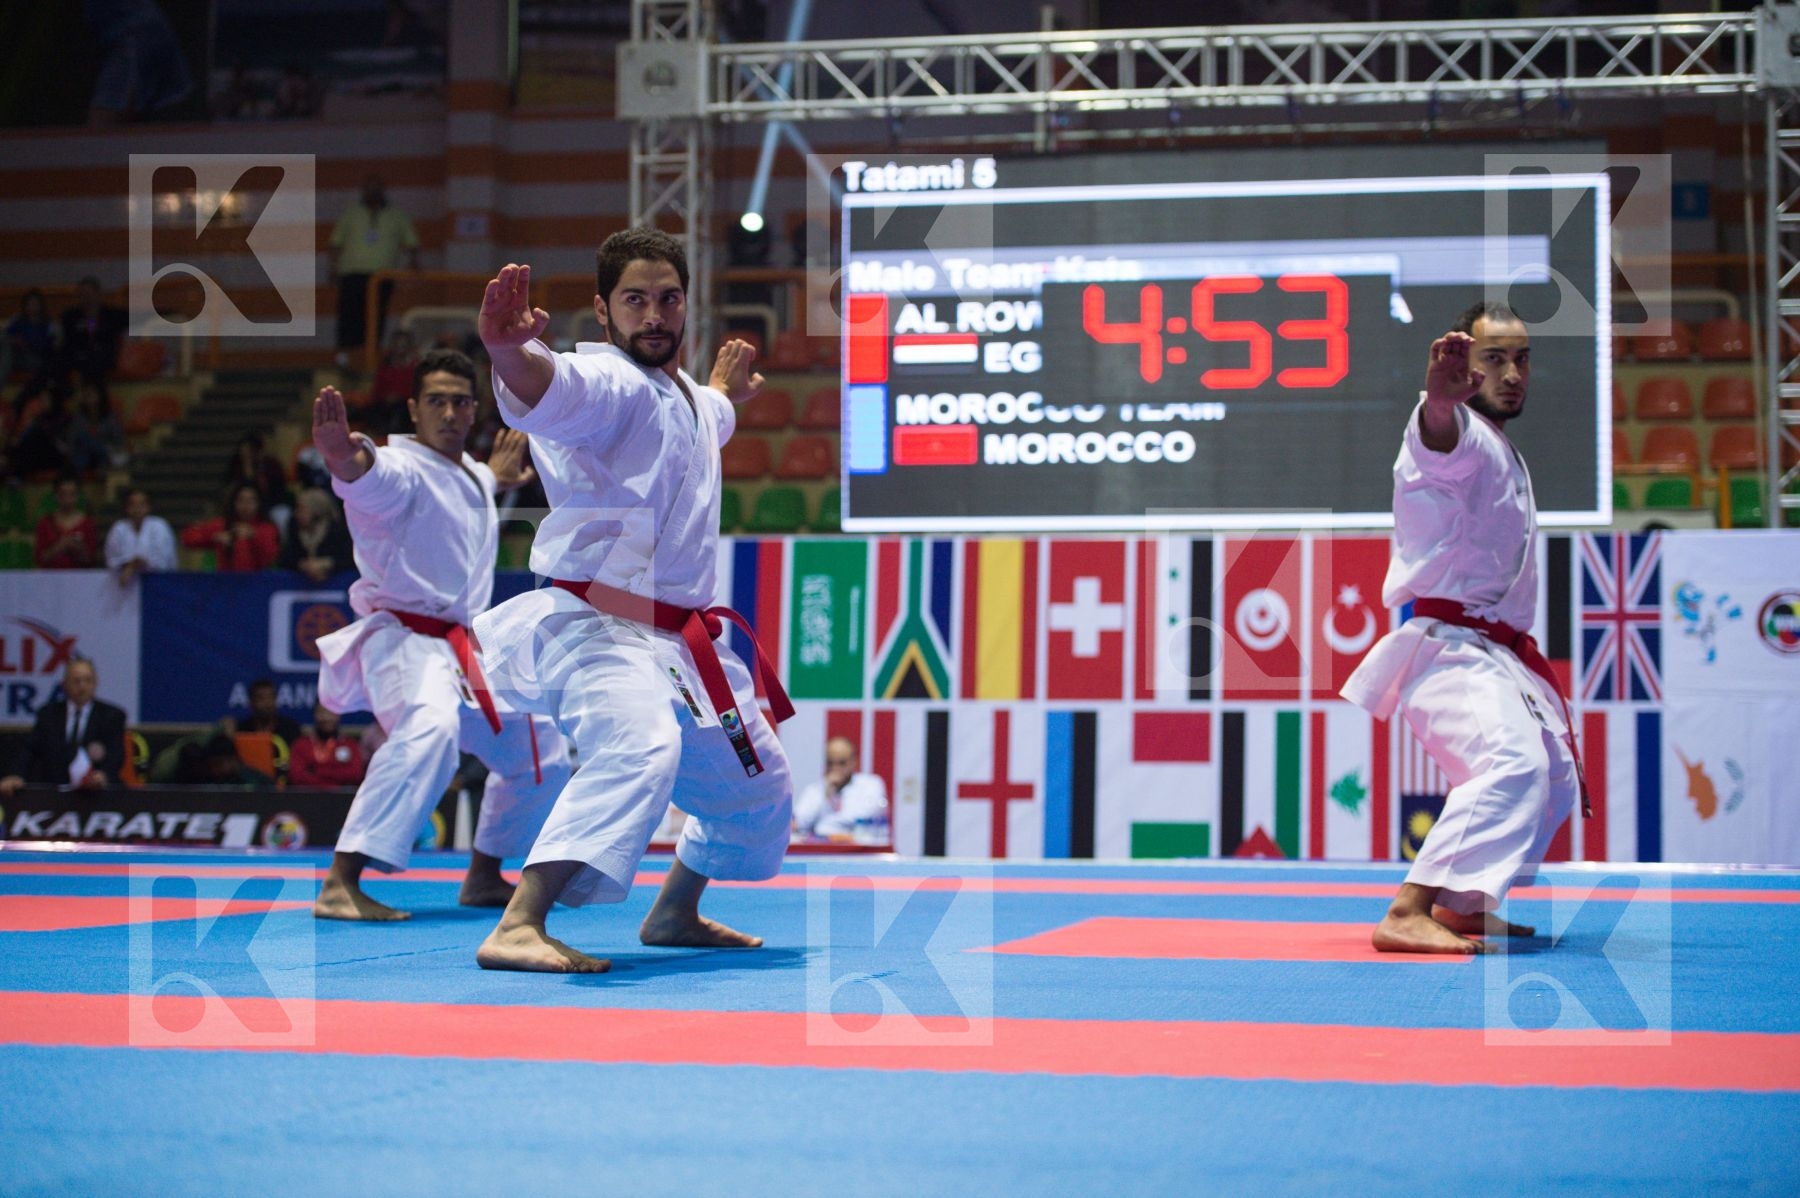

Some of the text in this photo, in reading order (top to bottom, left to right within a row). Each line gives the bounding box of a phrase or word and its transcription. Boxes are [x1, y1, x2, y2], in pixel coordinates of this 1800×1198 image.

[842, 157, 998, 191] Tatami 5
[849, 260, 936, 292] Male
[894, 303, 950, 333] AL
[1083, 273, 1349, 389] 4:53
[983, 430, 1196, 465] MOROCCO
